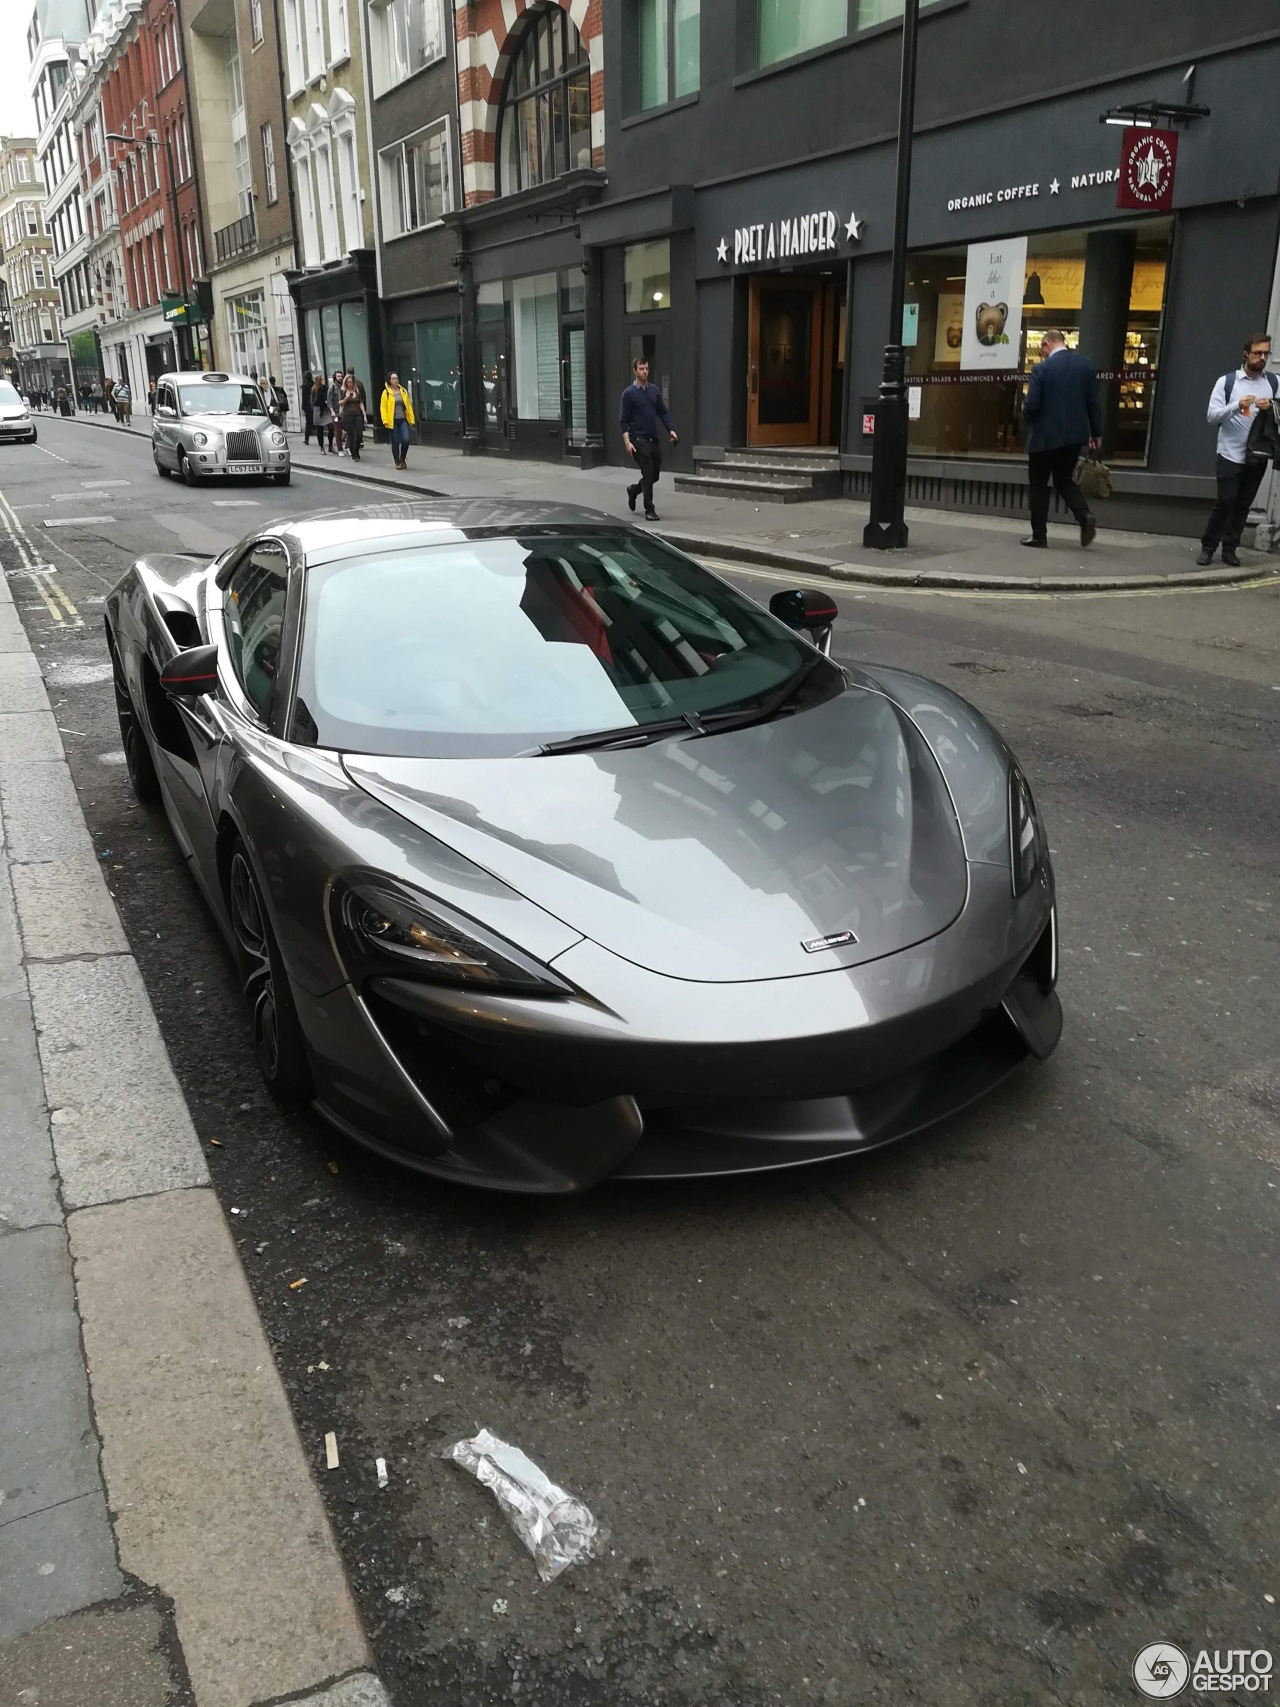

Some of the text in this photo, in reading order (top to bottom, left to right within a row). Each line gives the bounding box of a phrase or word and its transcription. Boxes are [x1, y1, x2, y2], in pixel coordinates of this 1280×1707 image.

[1128, 135, 1172, 168] ORGANIC COFFEE
[1137, 156, 1163, 184] PRET
[947, 168, 1120, 211] ORGANIC COFFEE NATURA
[1128, 176, 1169, 203] NATURAL FOOD
[734, 210, 836, 264] PRET A MANGER
[989, 252, 1002, 264] Eat
[904, 376, 924, 384] OASTIES
[959, 374, 994, 382] SANDWICHES
[1125, 371, 1146, 379] LATTE
[811, 935, 849, 948] McLaren
